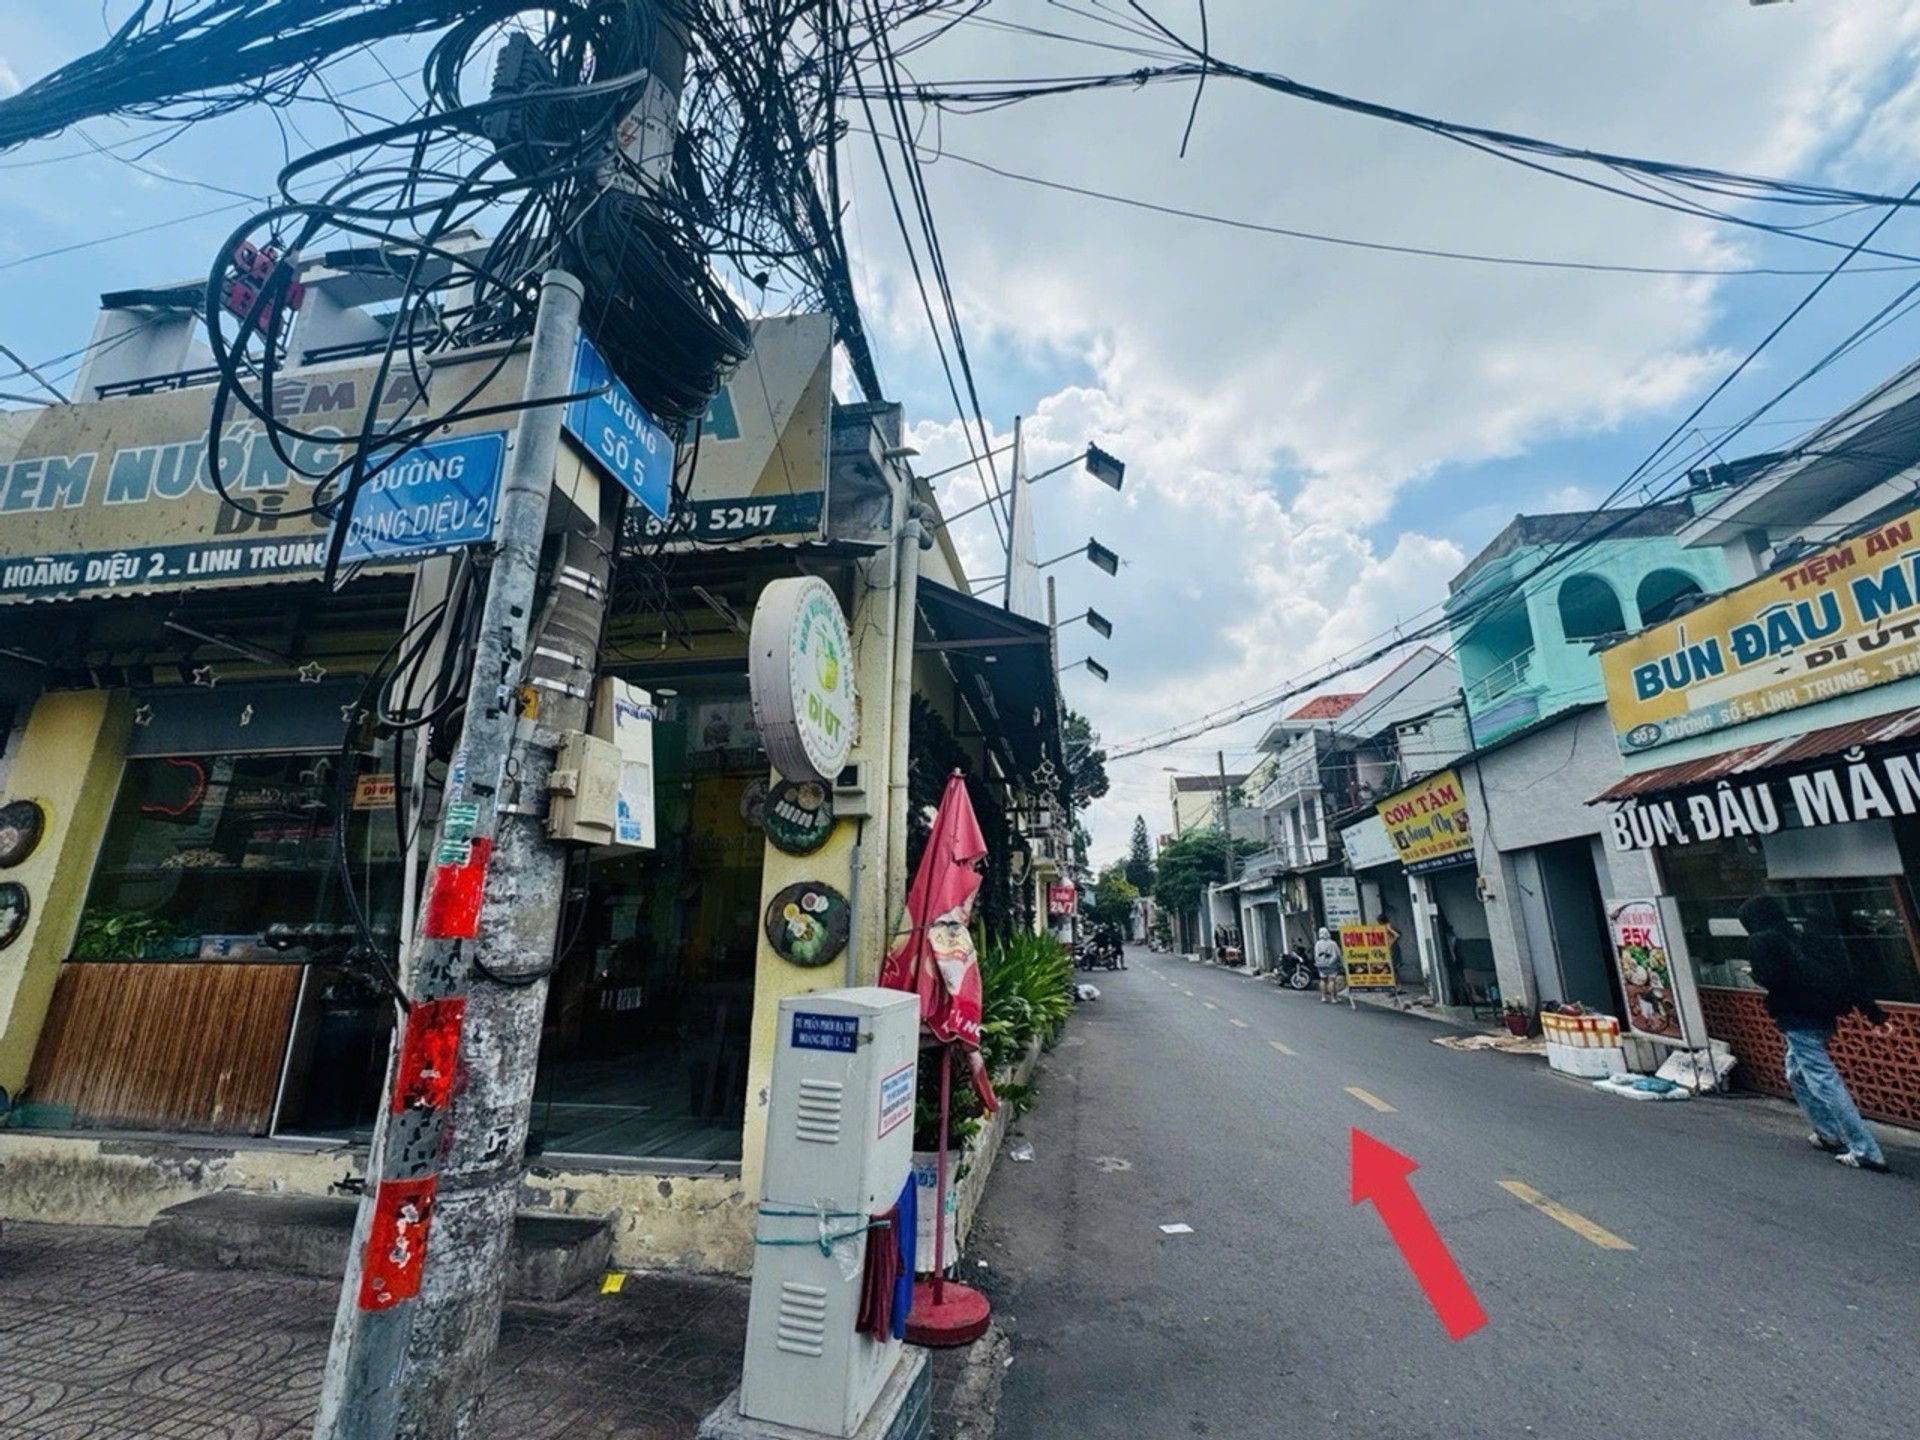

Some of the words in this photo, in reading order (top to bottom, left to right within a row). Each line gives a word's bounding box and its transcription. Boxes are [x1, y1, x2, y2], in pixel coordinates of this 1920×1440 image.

[211, 378, 356, 424] TỆM
[601, 379, 656, 454] ĐƯỜNG
[0, 453, 98, 513] EM
[101, 421, 345, 505] NƯỚNG
[371, 455, 465, 493] ĐƯỜNG
[601, 427, 634, 470] SỐ
[633, 458, 645, 487] 5
[346, 503, 408, 546] OÀNG
[412, 494, 469, 540] DIỆU
[472, 496, 488, 529] 2
[708, 504, 778, 531] 5247
[3, 556, 78, 588] HOÀNG
[85, 553, 140, 588] DIỆU
[148, 553, 165, 578] 2
[187, 548, 243, 574] LINH
[1780, 547, 1857, 592] TIỆM
[1861, 521, 1913, 557] ĂN
[1633, 624, 1724, 701] BÚN
[1730, 591, 1843, 667] ĐẬU
[1851, 551, 1920, 622] M
[1857, 618, 1920, 652] ÚT
[1649, 728, 1657, 741] 2
[1665, 713, 1712, 740] ĐƯỜNG
[1720, 699, 1740, 723] SỐ
[1802, 668, 1869, 702] TRUNG
[1384, 801, 1417, 826] CƠM
[1416, 782, 1459, 813] TẤM
[1622, 928, 1652, 947] 25K
